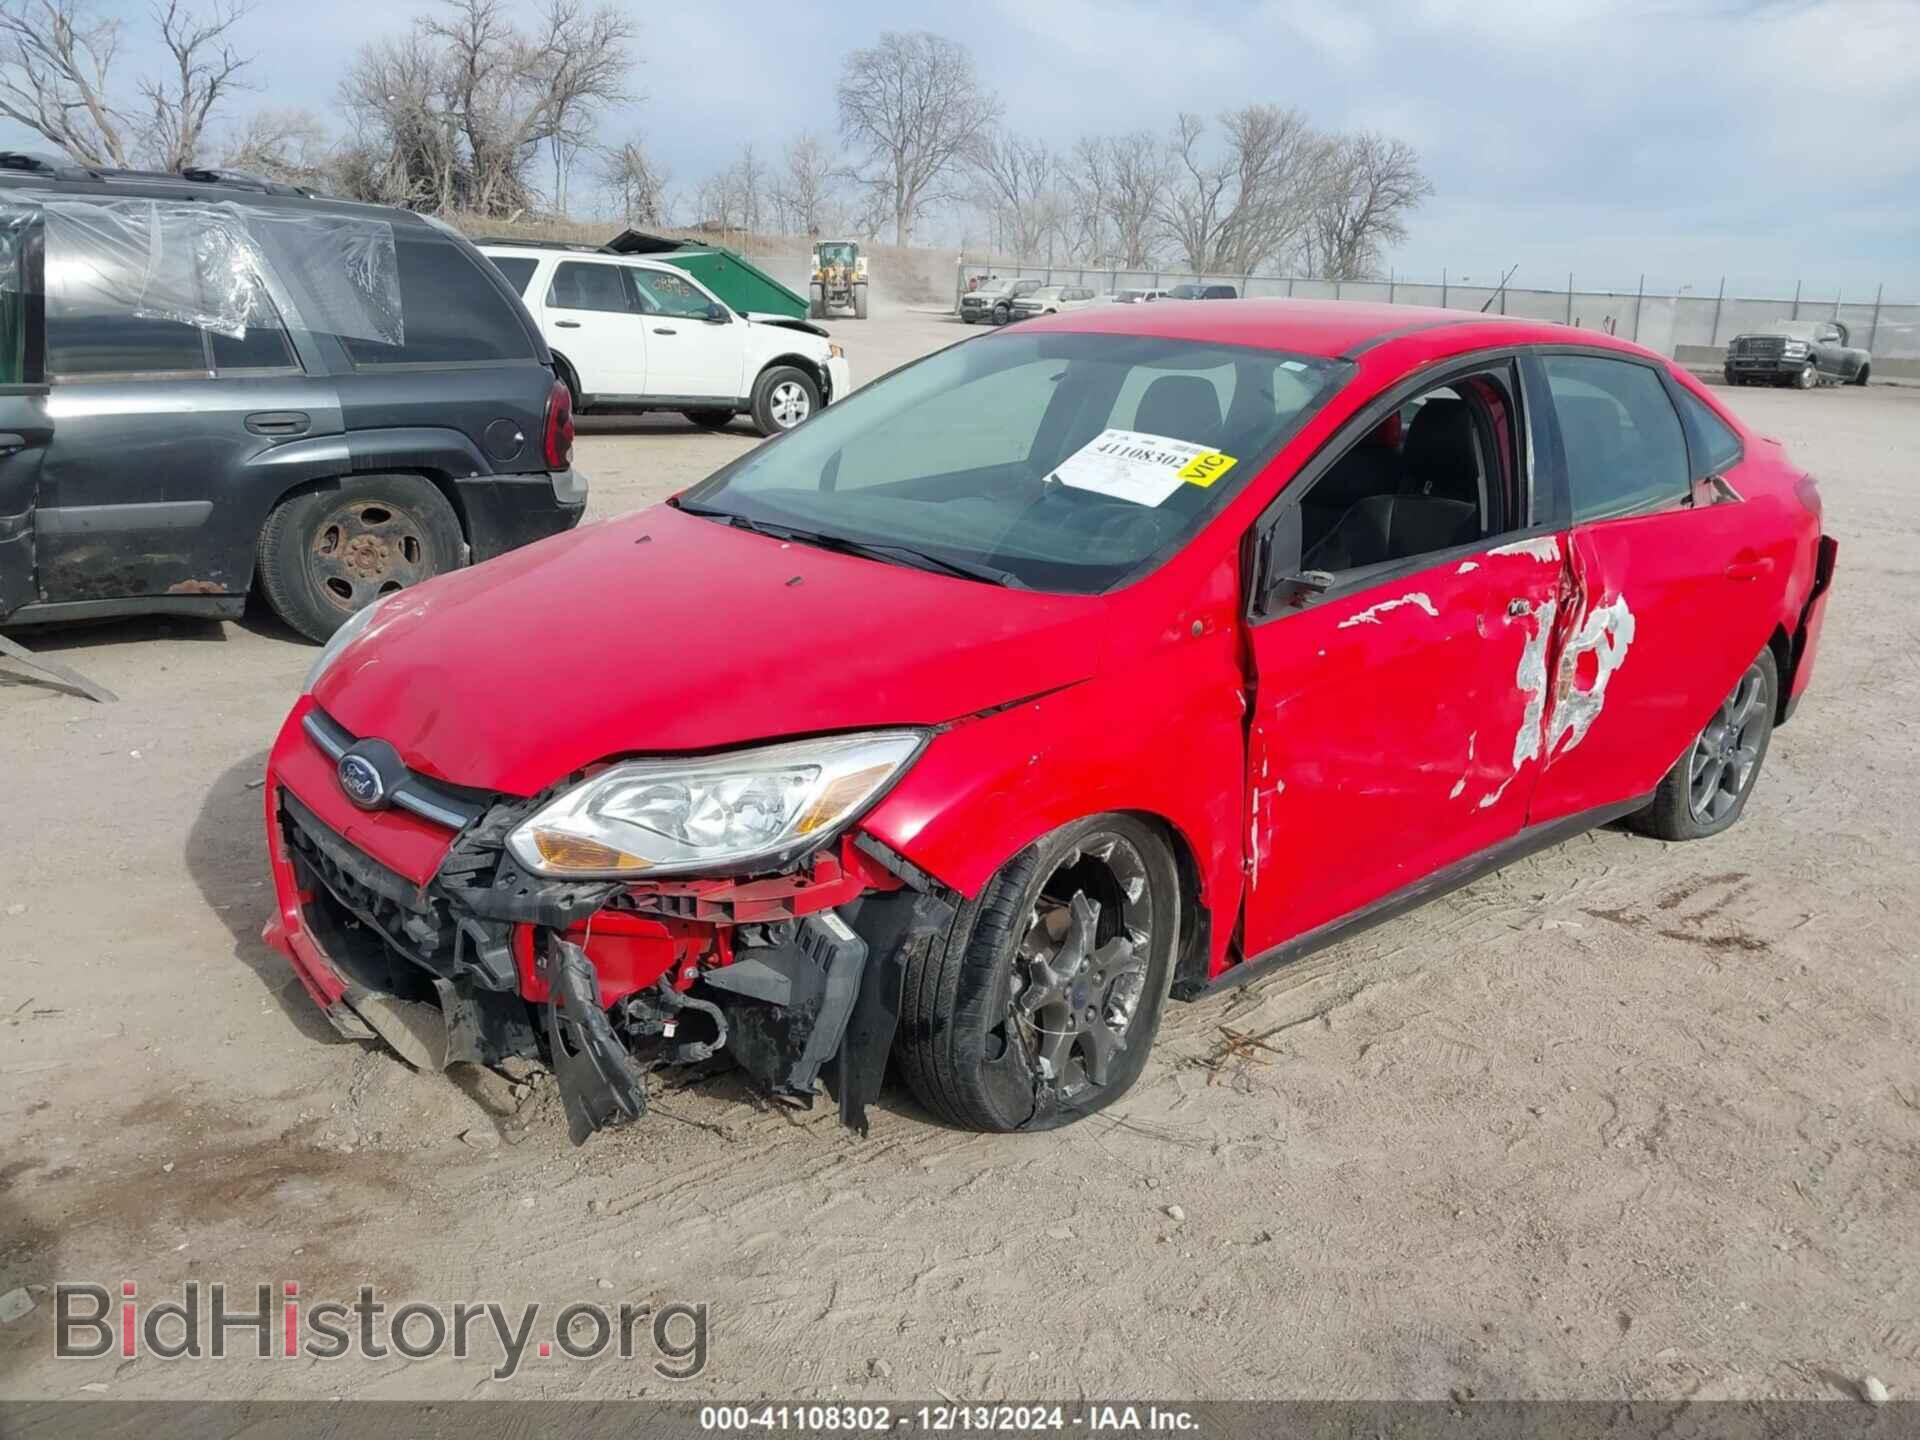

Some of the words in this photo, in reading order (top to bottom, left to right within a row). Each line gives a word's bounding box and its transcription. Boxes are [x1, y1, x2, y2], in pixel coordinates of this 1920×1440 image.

[1098, 442, 1189, 469] 41108302
[1184, 455, 1225, 481] VIC
[344, 762, 371, 795] Ford
